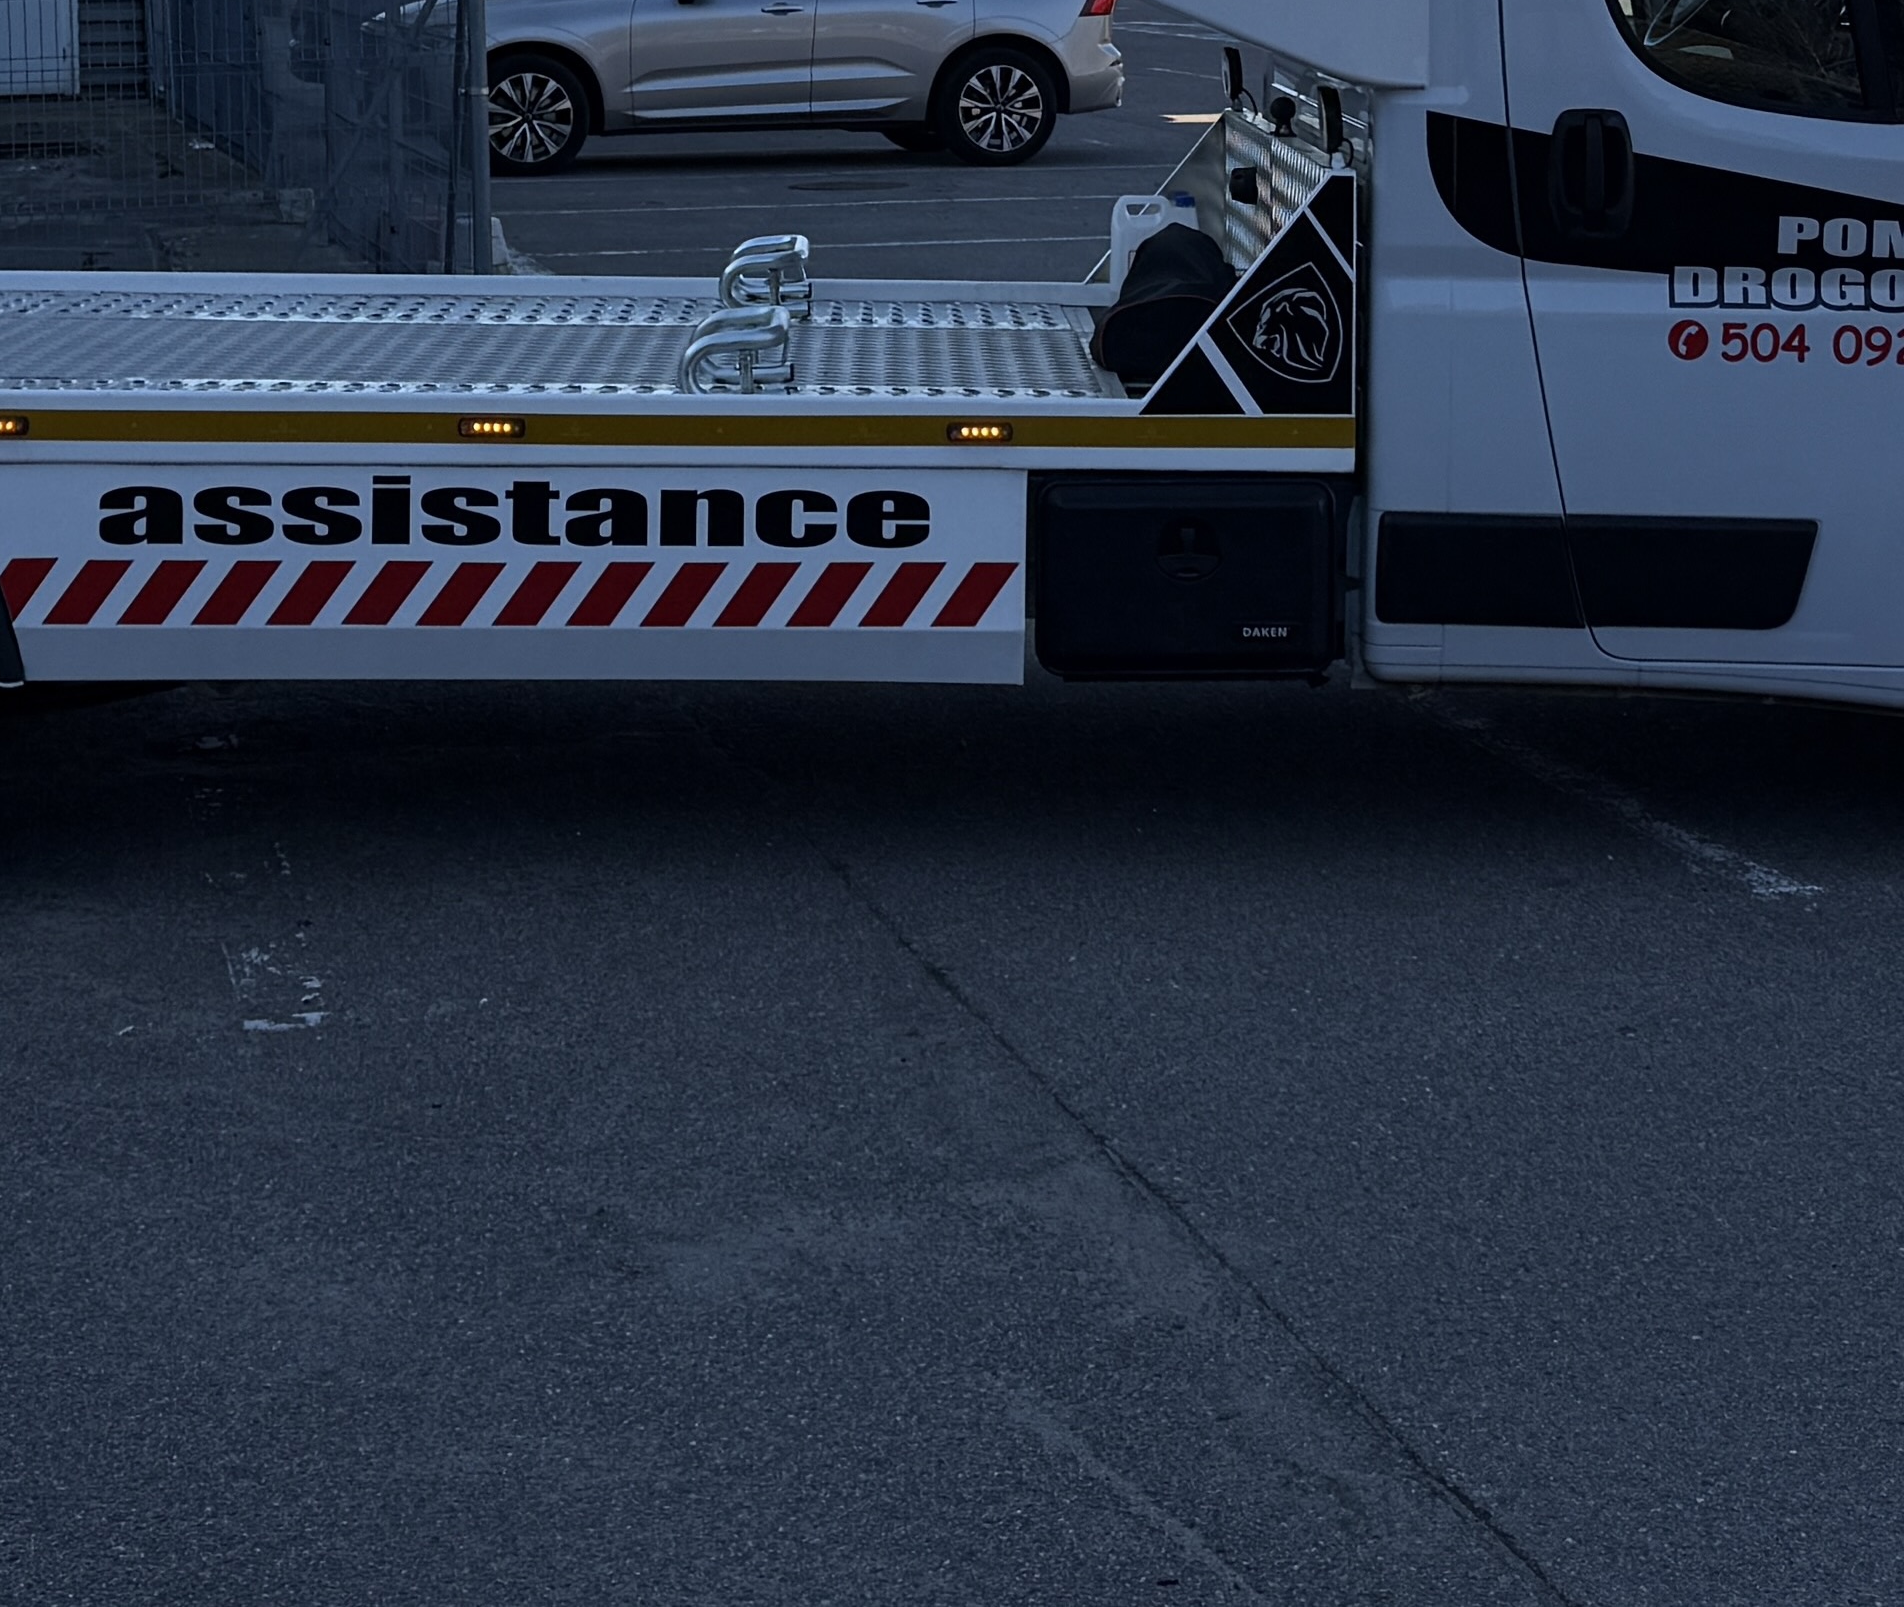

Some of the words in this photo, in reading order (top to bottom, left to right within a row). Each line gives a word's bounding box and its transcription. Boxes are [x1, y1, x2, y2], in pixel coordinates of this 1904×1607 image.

[1721, 322, 1810, 364] 504
[99, 475, 930, 549] assistance
[1242, 627, 1287, 638] DAKEN
